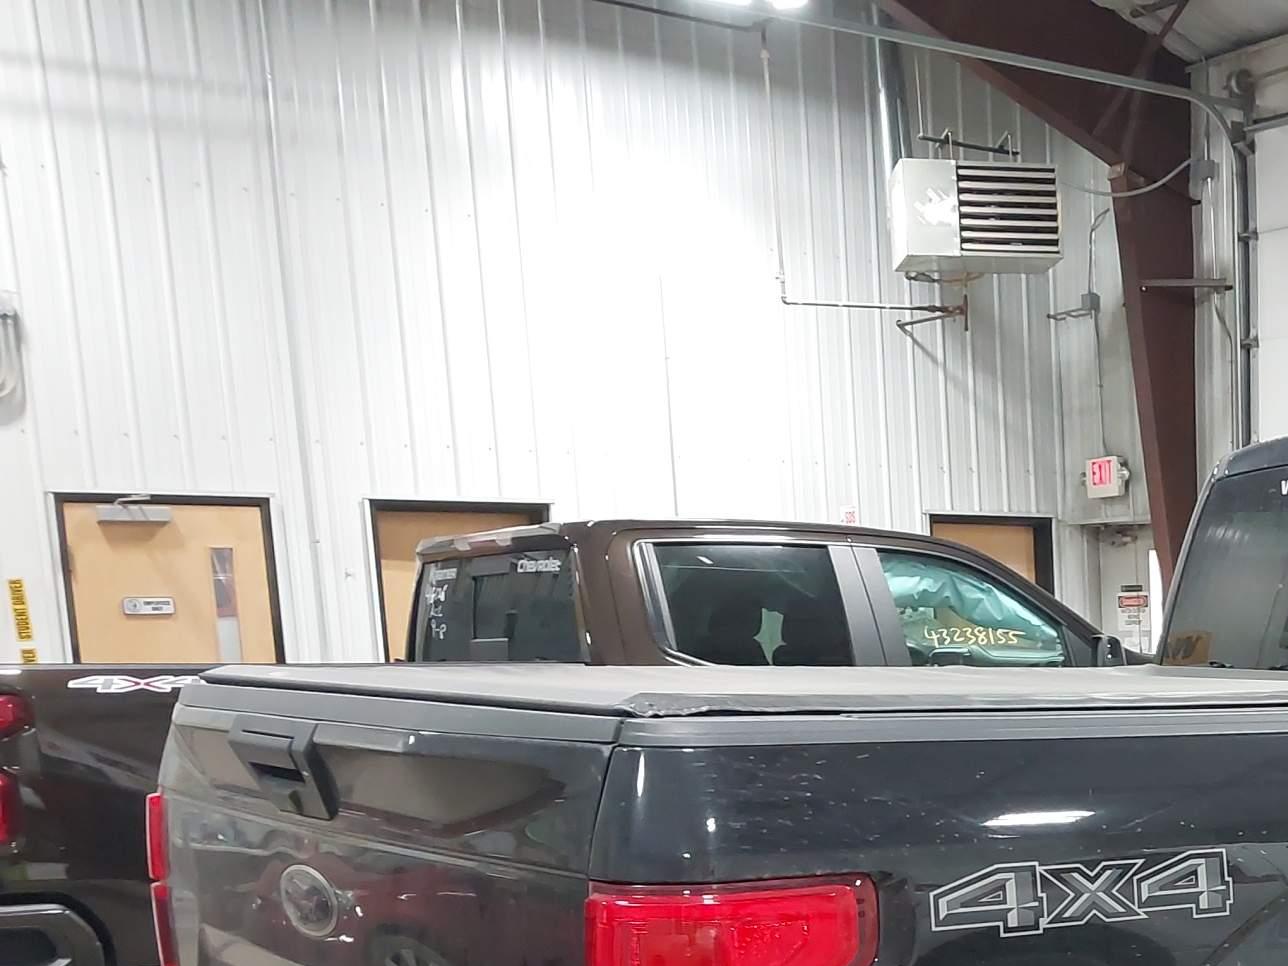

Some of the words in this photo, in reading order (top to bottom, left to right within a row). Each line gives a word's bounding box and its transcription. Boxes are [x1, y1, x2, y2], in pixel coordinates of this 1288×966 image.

[1091, 460, 1112, 486] EXIT
[8, 579, 25, 606] DRIVER
[14, 607, 32, 640] STUDENT
[924, 625, 1027, 649] 43238155
